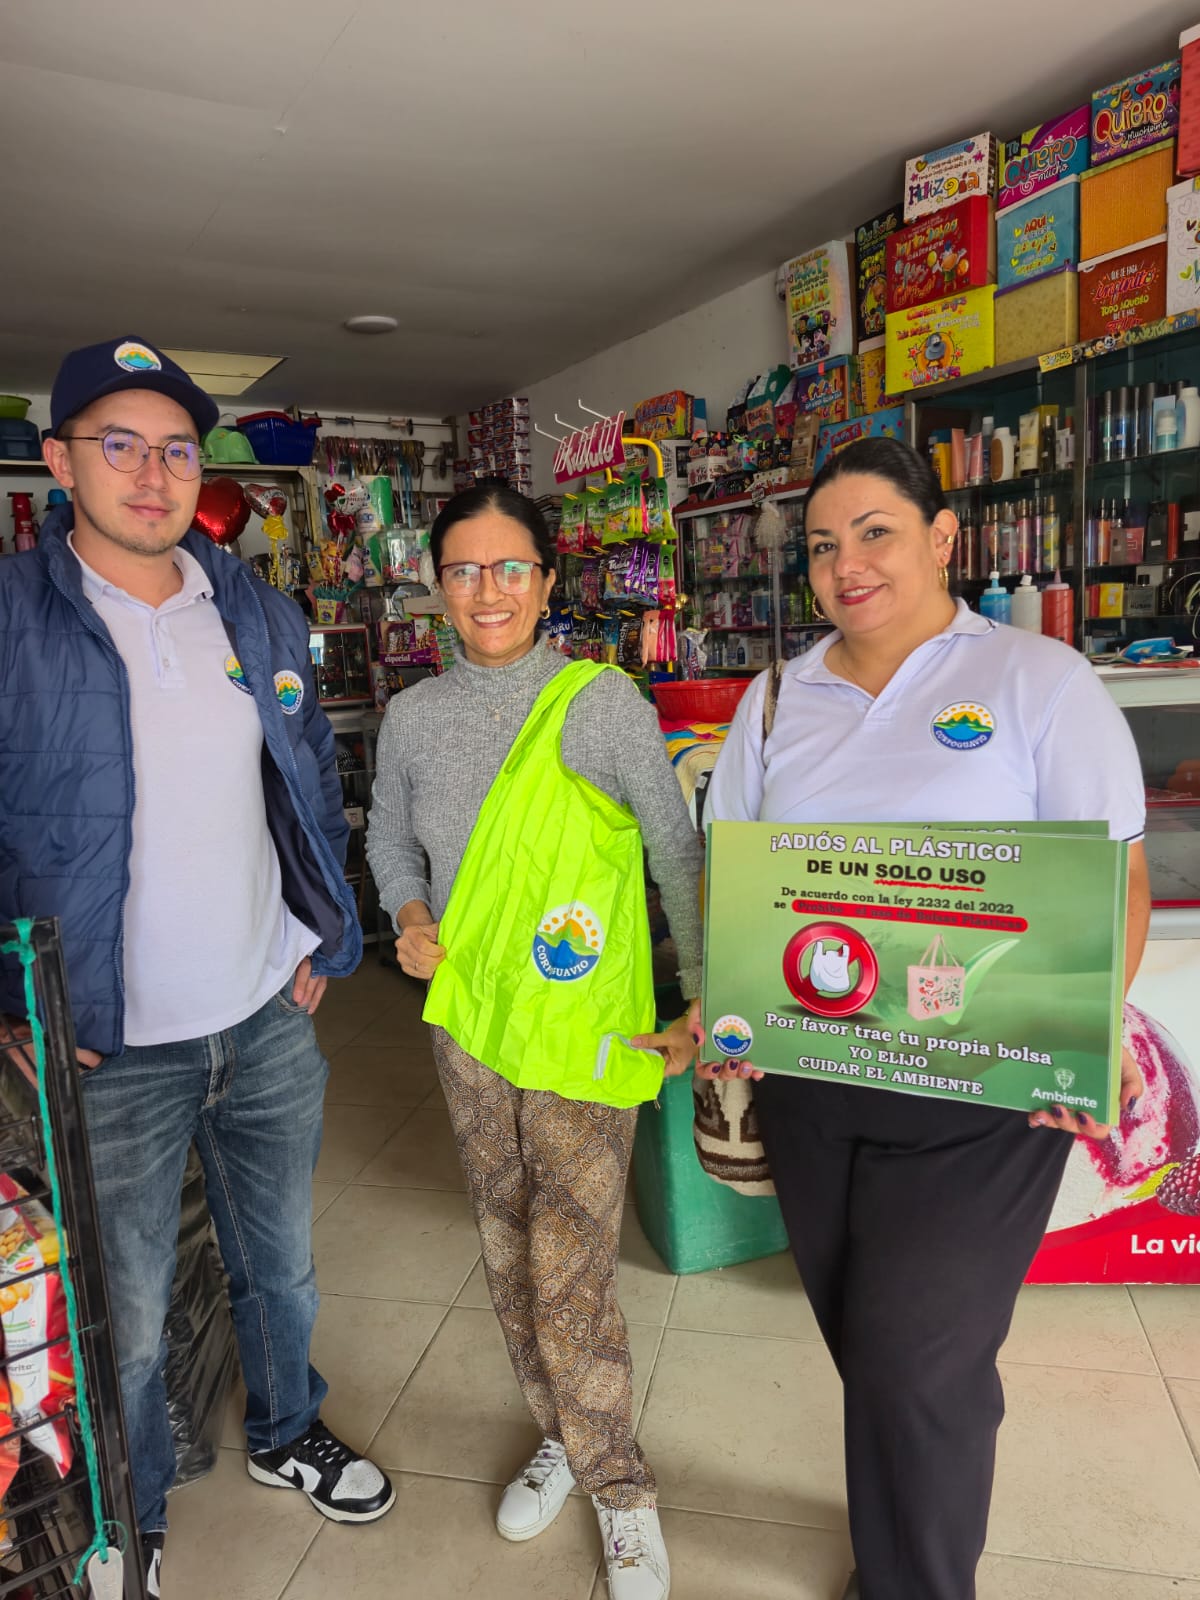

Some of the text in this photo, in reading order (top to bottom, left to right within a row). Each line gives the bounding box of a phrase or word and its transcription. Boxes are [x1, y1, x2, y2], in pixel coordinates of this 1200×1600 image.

[770, 831, 1022, 863] ¡ADIÓS AL PLÁSTICO!
[807, 859, 986, 885] DE UN SOLO USO
[781, 887, 1014, 914] De acuerdo con la ley 2232 del 2022
[765, 1012, 1053, 1066] Por favor trae tu propia bolsa
[848, 1046, 928, 1069] YO ELIJO
[798, 1056, 985, 1096] CUIDAR EL AMBIENTE
[1031, 1087, 1098, 1109] Ambiente
[1131, 1234, 1164, 1254] La
